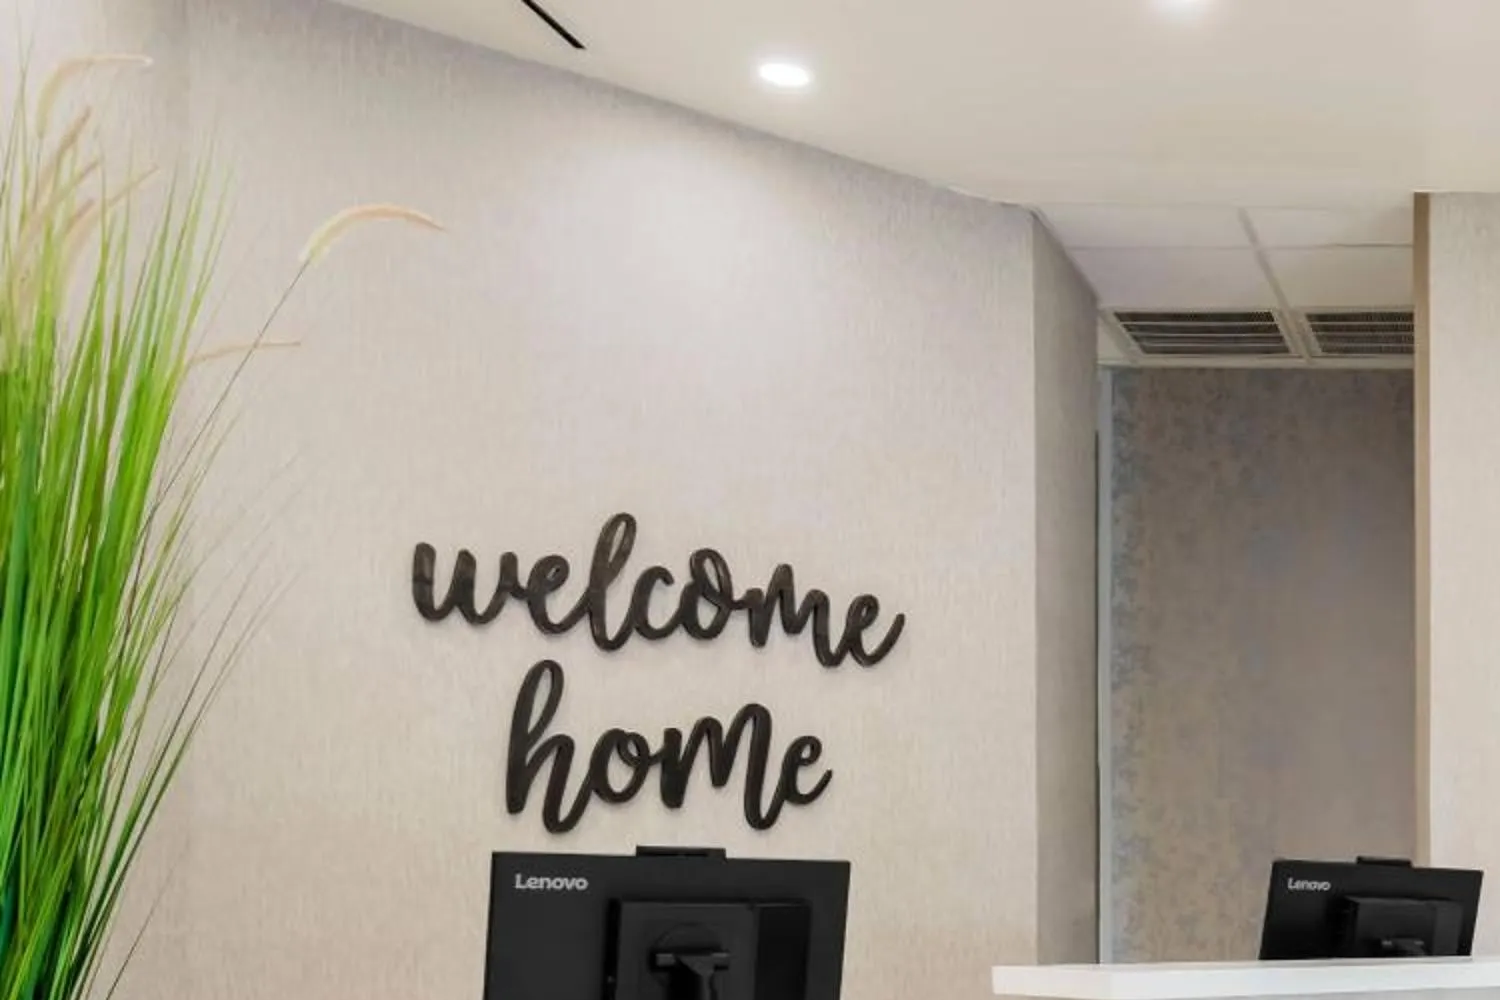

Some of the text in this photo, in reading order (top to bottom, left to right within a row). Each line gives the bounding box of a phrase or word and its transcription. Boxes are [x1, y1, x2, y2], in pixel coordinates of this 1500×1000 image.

[412, 513, 905, 668] welcome
[505, 659, 833, 835] home
[515, 873, 589, 891] Lenovo
[1287, 878, 1332, 892] Lenovo
